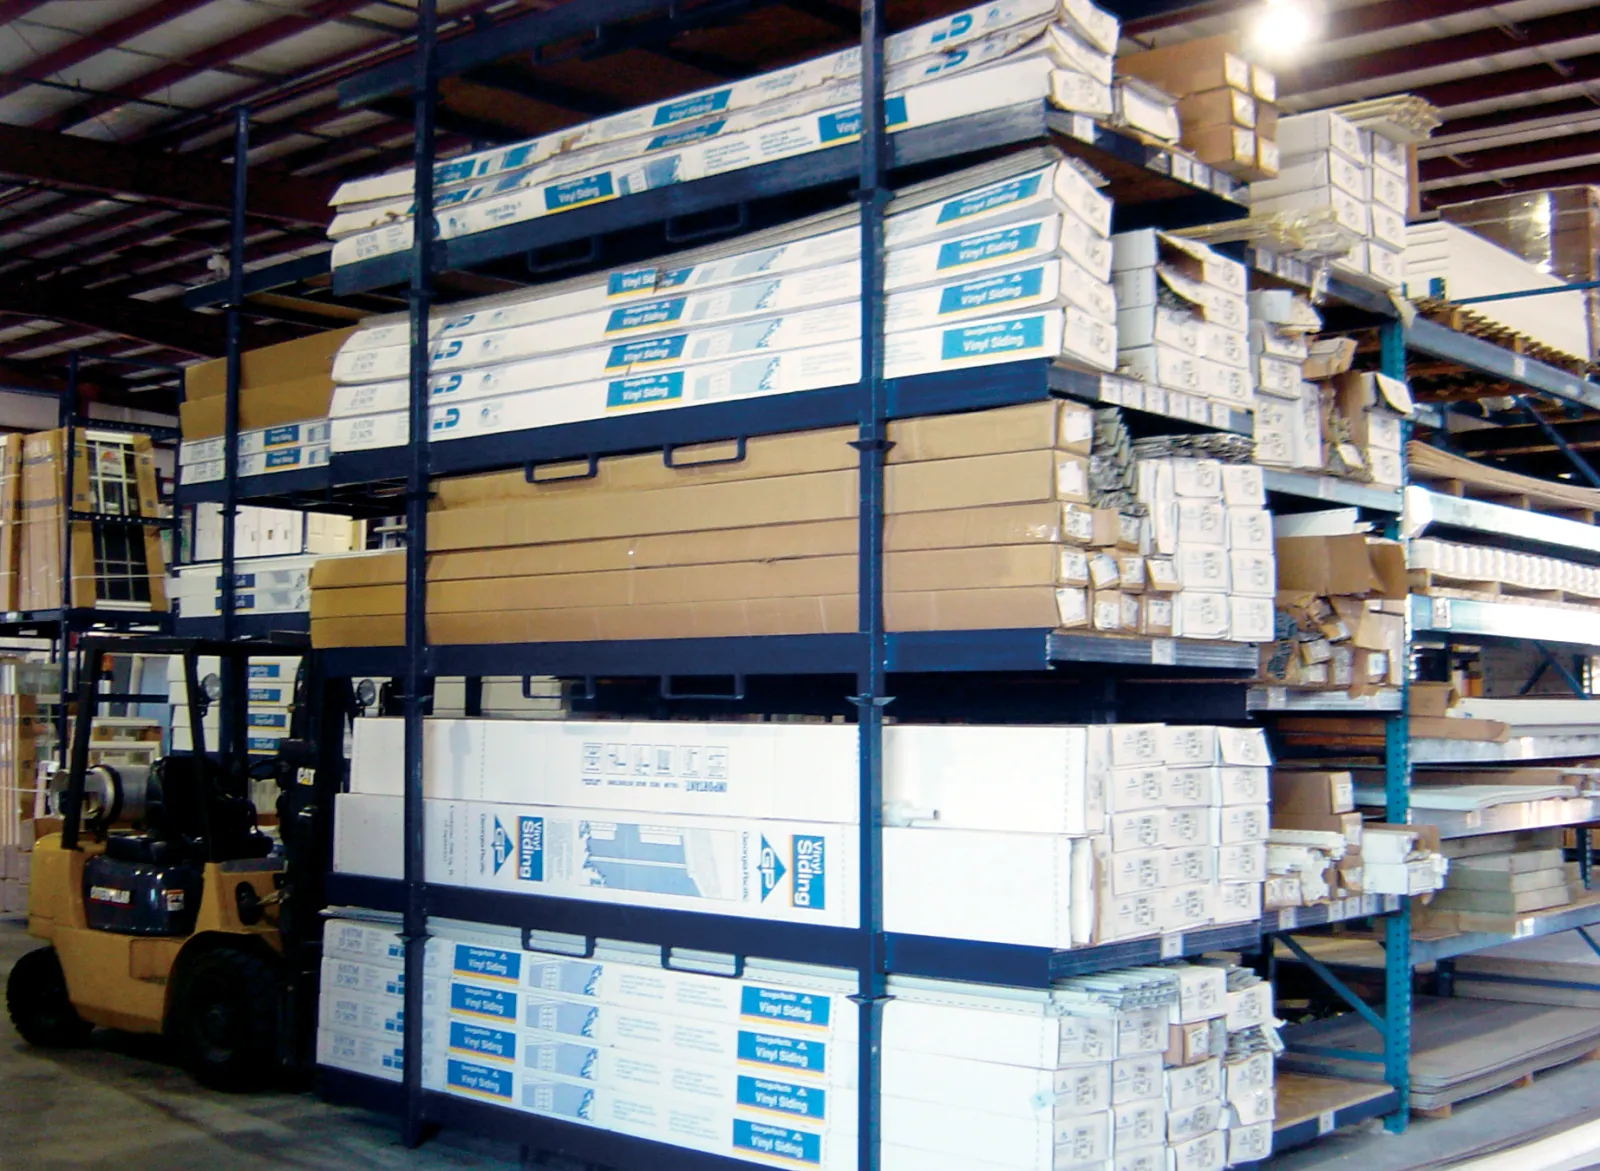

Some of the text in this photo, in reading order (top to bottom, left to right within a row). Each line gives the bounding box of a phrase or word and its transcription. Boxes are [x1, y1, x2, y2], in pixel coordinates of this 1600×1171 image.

[837, 118, 860, 133] Vinyl
[558, 187, 600, 203] Vinyl Siding
[960, 190, 1019, 214] Vinyl Siding
[959, 240, 1019, 260] Vinyl Siding
[622, 277, 642, 288] Vinyl
[961, 286, 1022, 305] Vinyl Siding
[623, 312, 669, 327] Vinyl Siding
[963, 334, 1025, 352] Vinyl Siding
[624, 349, 669, 363] Vinyl Siding
[622, 387, 669, 401] Vinyl Siding
[297, 767, 315, 785] CAT
[532, 821, 542, 851] Vinyl
[520, 820, 535, 878] Siding
[811, 841, 823, 875] Vinyl
[762, 847, 775, 889] GP
[794, 840, 813, 906] Siding
[468, 959, 507, 975] Vinyl Siding
[464, 997, 504, 1015] Vinyl Siding
[759, 1001, 812, 1021] Vinyl Siding
[464, 1036, 503, 1054] Vinyl Siding
[755, 1046, 808, 1067] Vinyl Siding
[461, 1074, 500, 1093] Vinyl Siding
[755, 1091, 808, 1114] Vinyl Siding
[751, 1135, 804, 1158] Vinyl Siding
